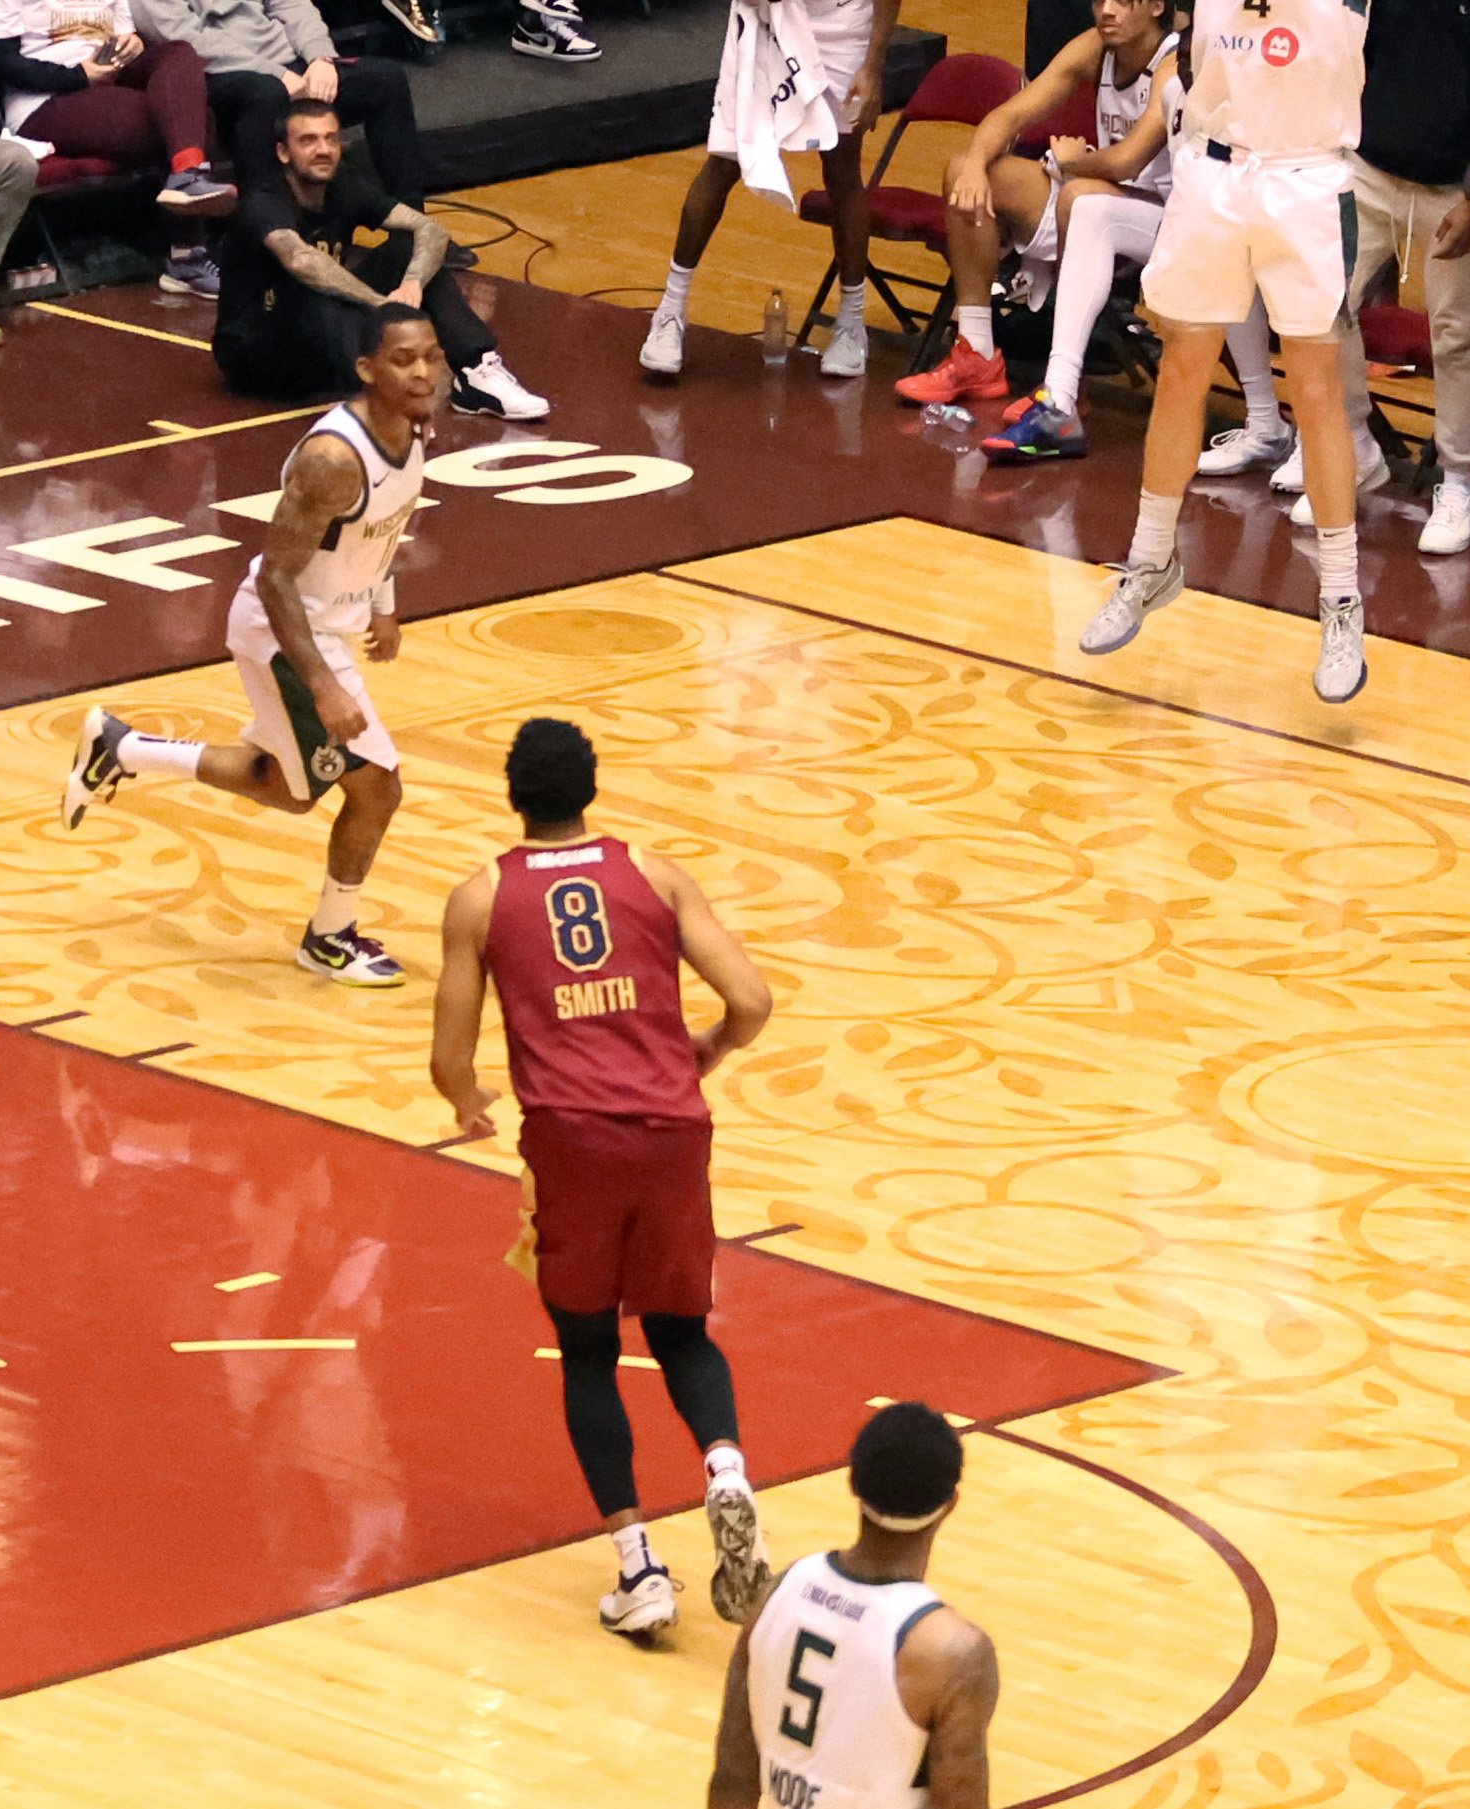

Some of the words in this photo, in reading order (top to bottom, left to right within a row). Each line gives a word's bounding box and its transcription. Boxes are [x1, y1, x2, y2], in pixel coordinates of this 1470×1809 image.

[545, 876, 614, 973] 8
[554, 976, 637, 1020] SMITH
[778, 1627, 837, 1748] 5
